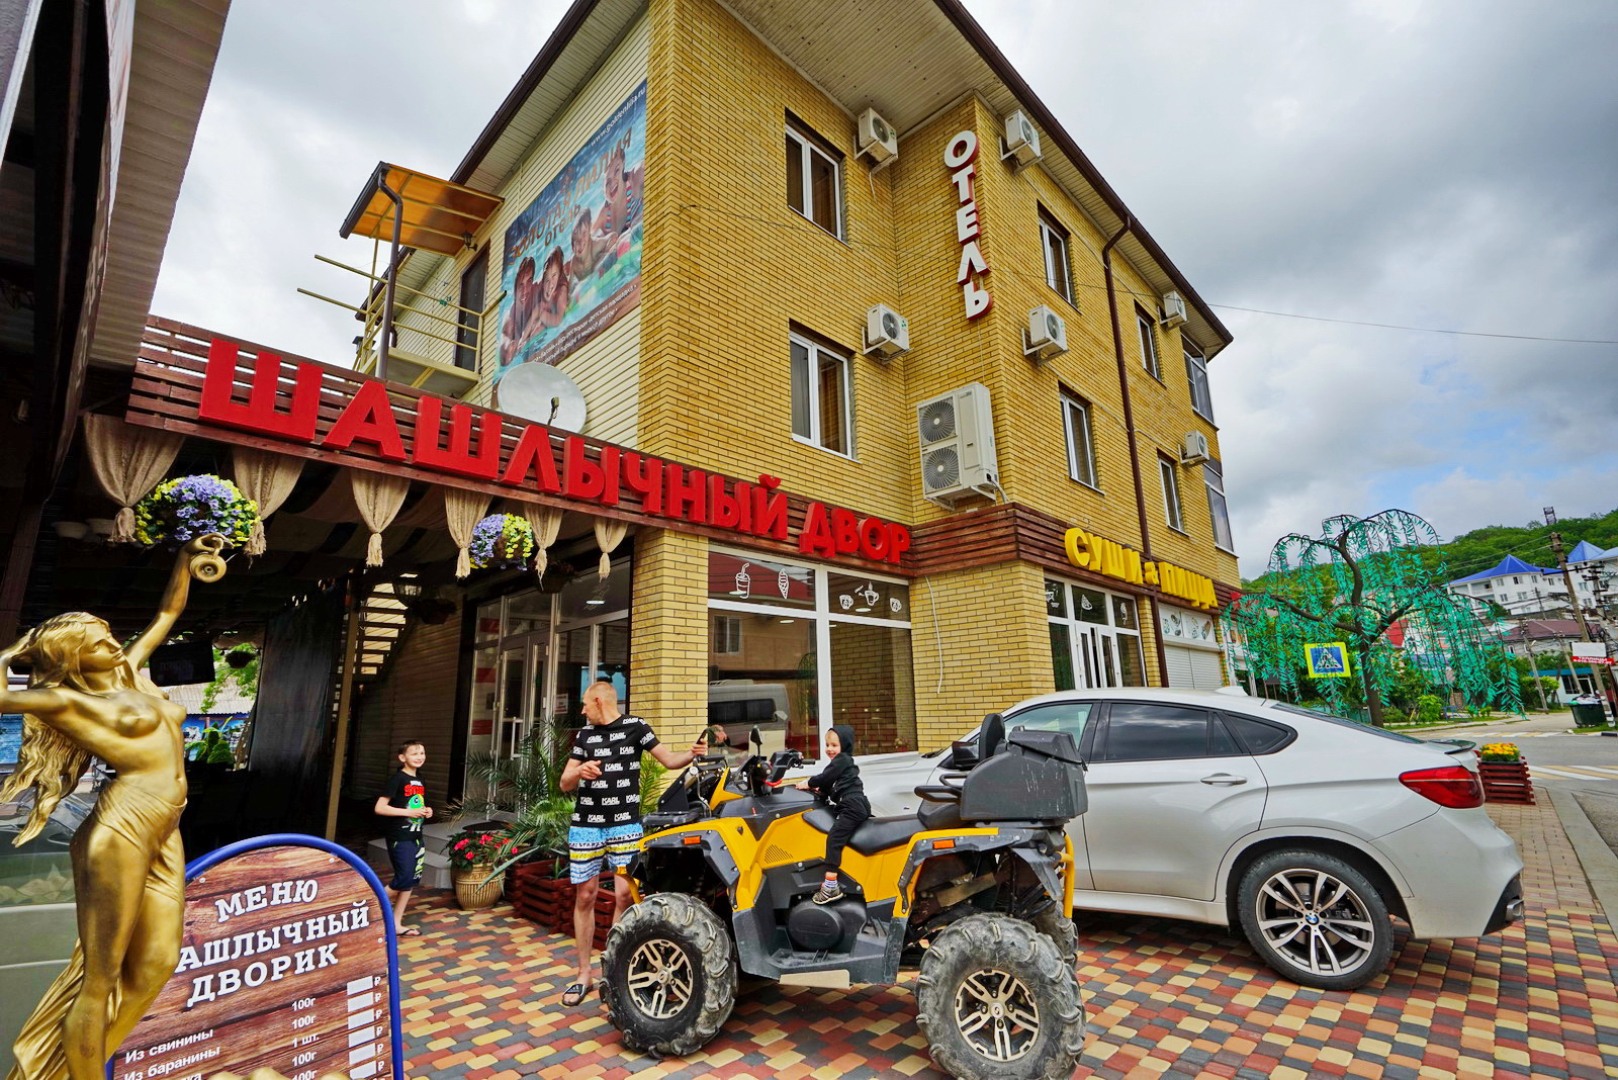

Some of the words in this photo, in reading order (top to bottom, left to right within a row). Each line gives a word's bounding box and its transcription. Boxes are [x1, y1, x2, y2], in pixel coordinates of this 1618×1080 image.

[944, 130, 992, 322] ОТЕЛЬ
[198, 338, 788, 541] ШАШЛЫЧНЫЙ
[799, 502, 911, 564] ДВОР
[1064, 527, 1144, 584] СУШИ
[1144, 561, 1159, 585] &
[1158, 561, 1218, 610] ПИЦЦА
[215, 879, 319, 923] МЕНЮ
[175, 899, 370, 973] АШЛЫЧНЫЙ
[186, 942, 339, 1008] ДВОРИК
[292, 997, 316, 1012] 100г
[292, 1015, 317, 1030] 100г
[125, 1049, 145, 1064] Из
[148, 1028, 214, 1056] свинины
[147, 1047, 221, 1077] баранины
[292, 1037, 298, 1048] 1
[292, 1051, 317, 1067] 100г
